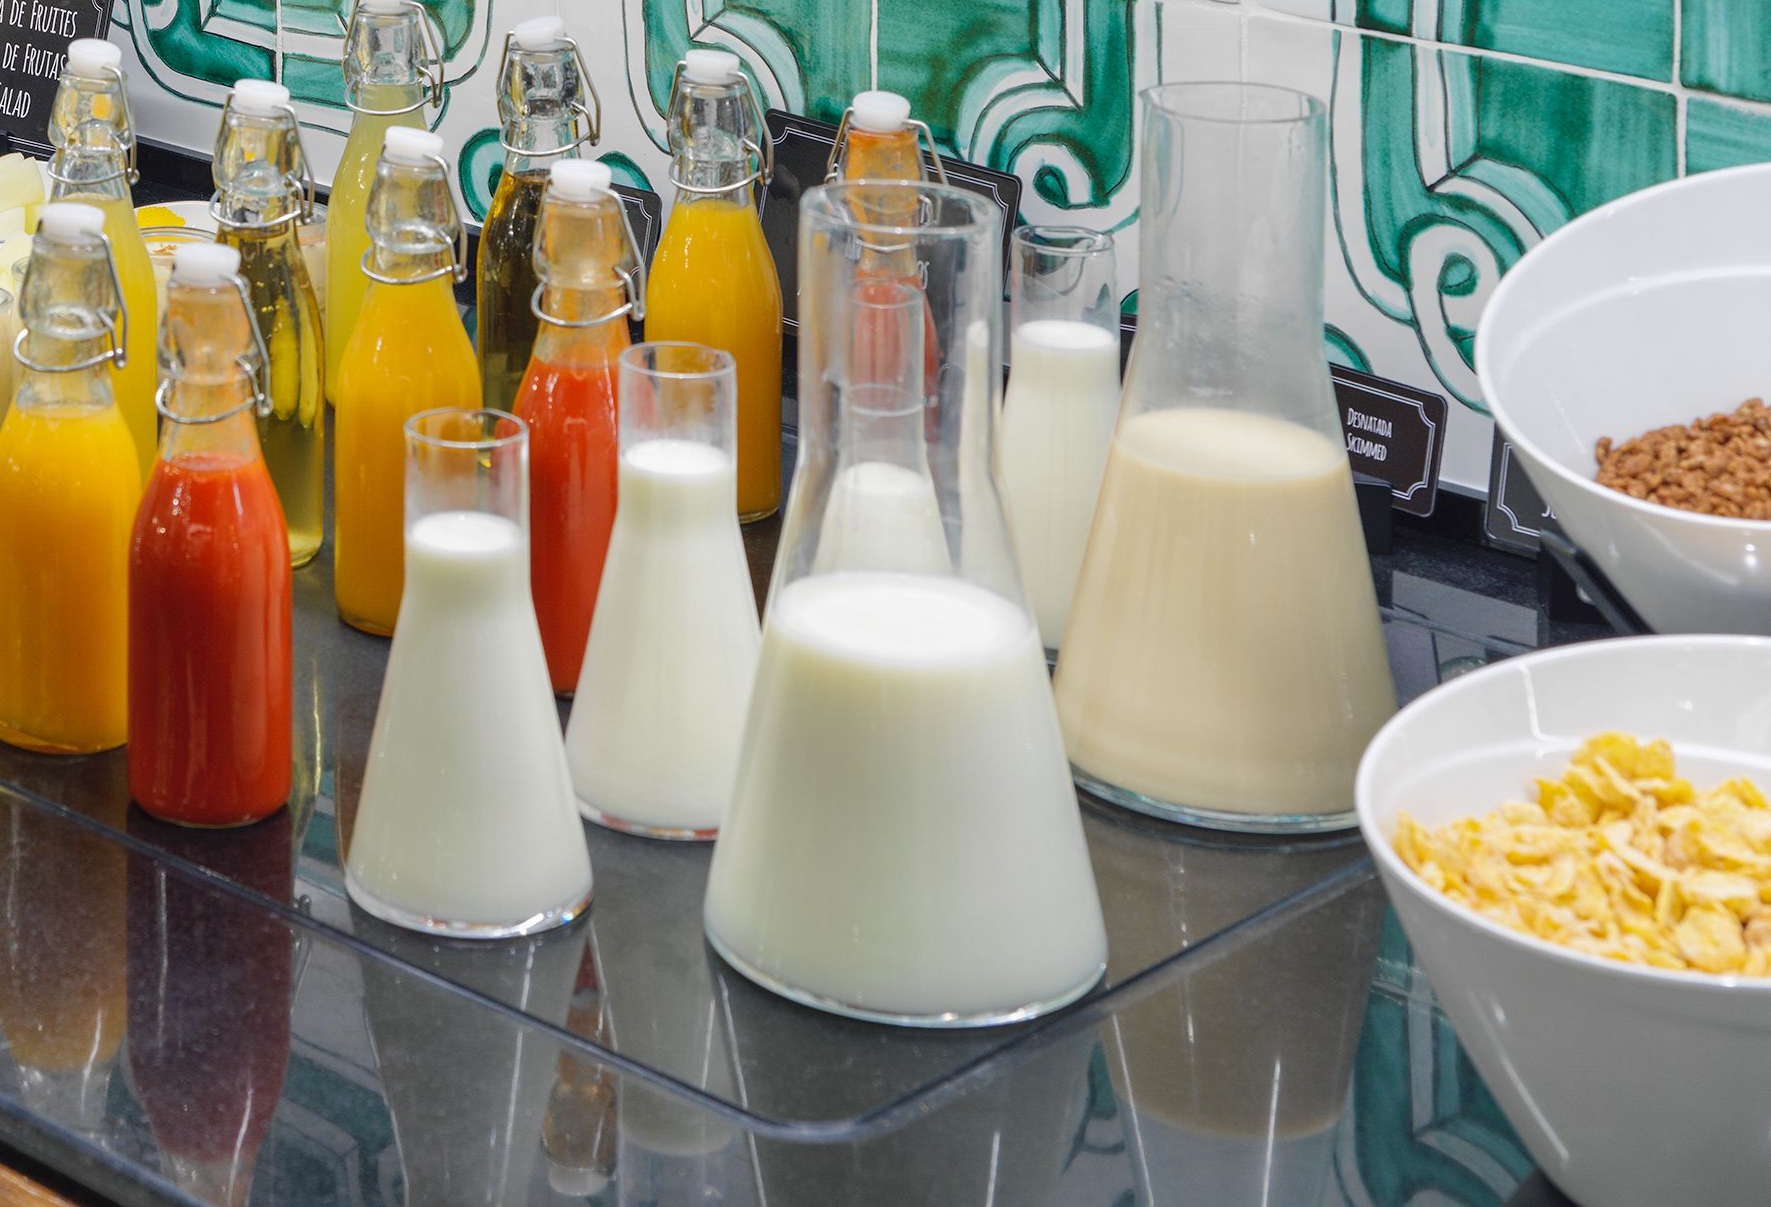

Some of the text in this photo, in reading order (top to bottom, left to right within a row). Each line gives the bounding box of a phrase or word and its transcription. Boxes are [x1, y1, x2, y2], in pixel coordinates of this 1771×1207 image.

[9, 0, 26, 28] DE
[30, 0, 78, 39] FRUITES
[2, 42, 20, 72] DE
[1347, 407, 1392, 439] DESNATADA
